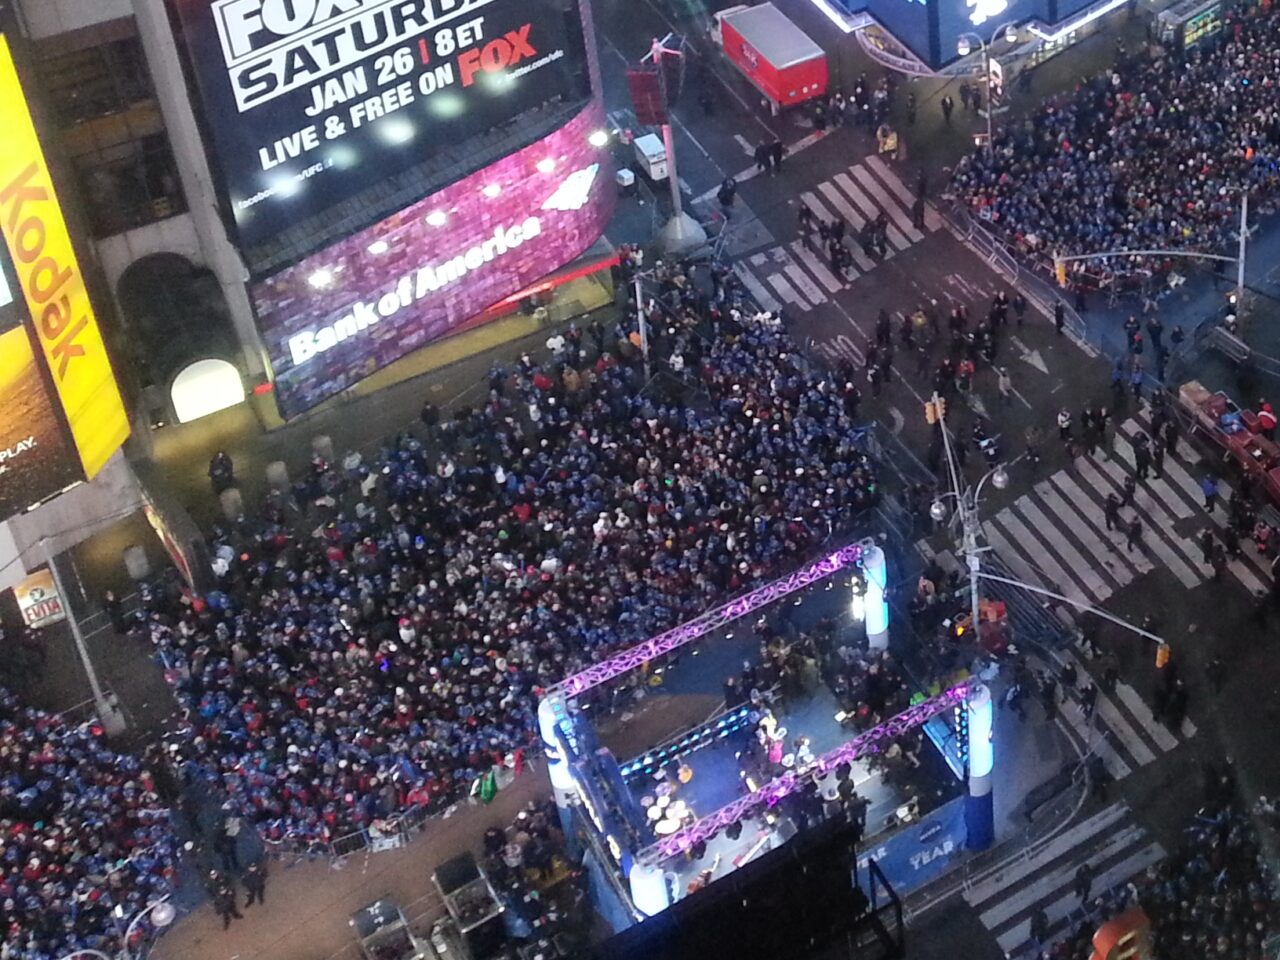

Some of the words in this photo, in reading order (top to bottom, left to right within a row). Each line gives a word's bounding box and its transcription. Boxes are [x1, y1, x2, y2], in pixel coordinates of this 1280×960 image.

[258, 124, 321, 171] LIVE
[323, 114, 347, 141] &
[348, 81, 416, 130] FREE
[418, 61, 455, 97] ON
[456, 22, 539, 89] FOX
[304, 65, 369, 117] JAN
[373, 45, 415, 82] 26
[0, 160, 89, 383] Kodak
[287, 301, 381, 367] Bank
[378, 274, 414, 317] of
[414, 215, 542, 300] America
[909, 839, 954, 871] YEAR
